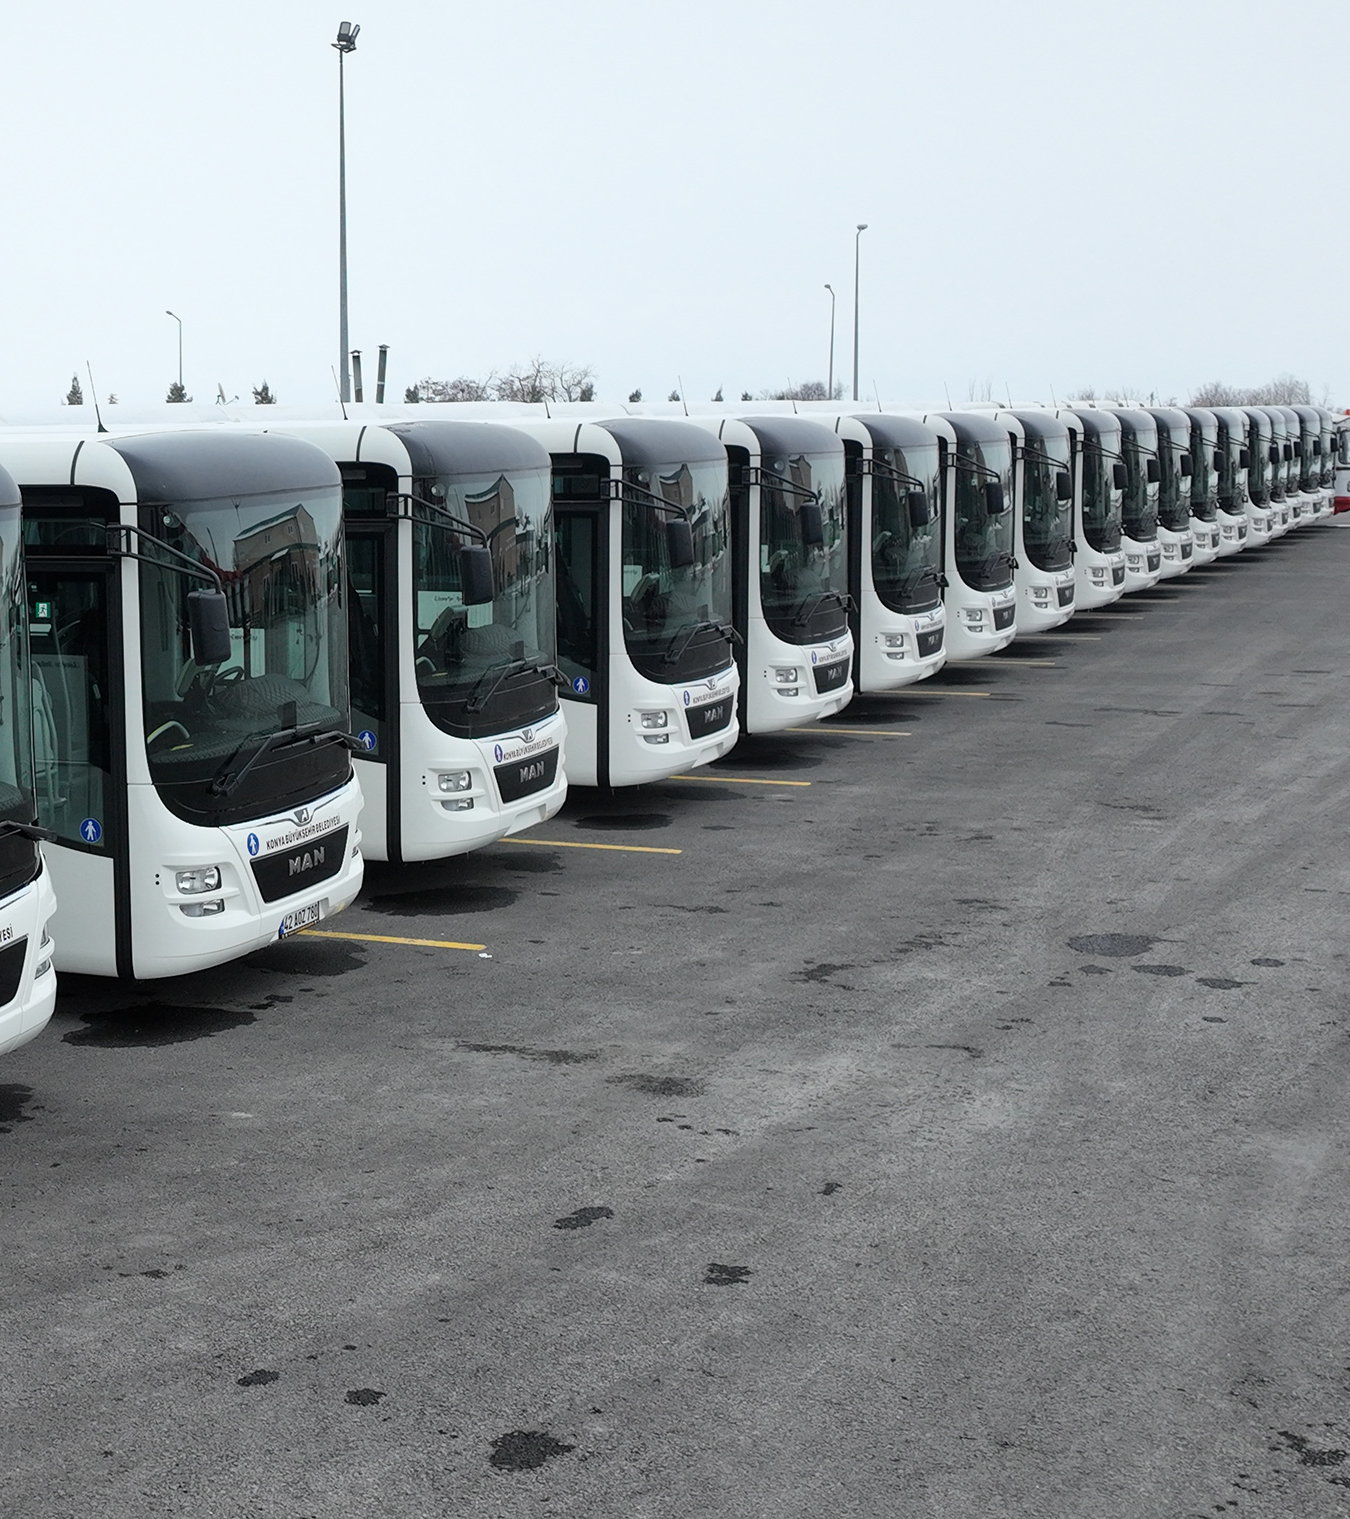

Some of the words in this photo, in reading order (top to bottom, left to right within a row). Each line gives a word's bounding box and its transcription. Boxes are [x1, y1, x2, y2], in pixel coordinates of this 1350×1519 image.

[519, 760, 545, 783] MAN
[265, 835, 286, 851] KONYA
[288, 845, 325, 877] MAN
